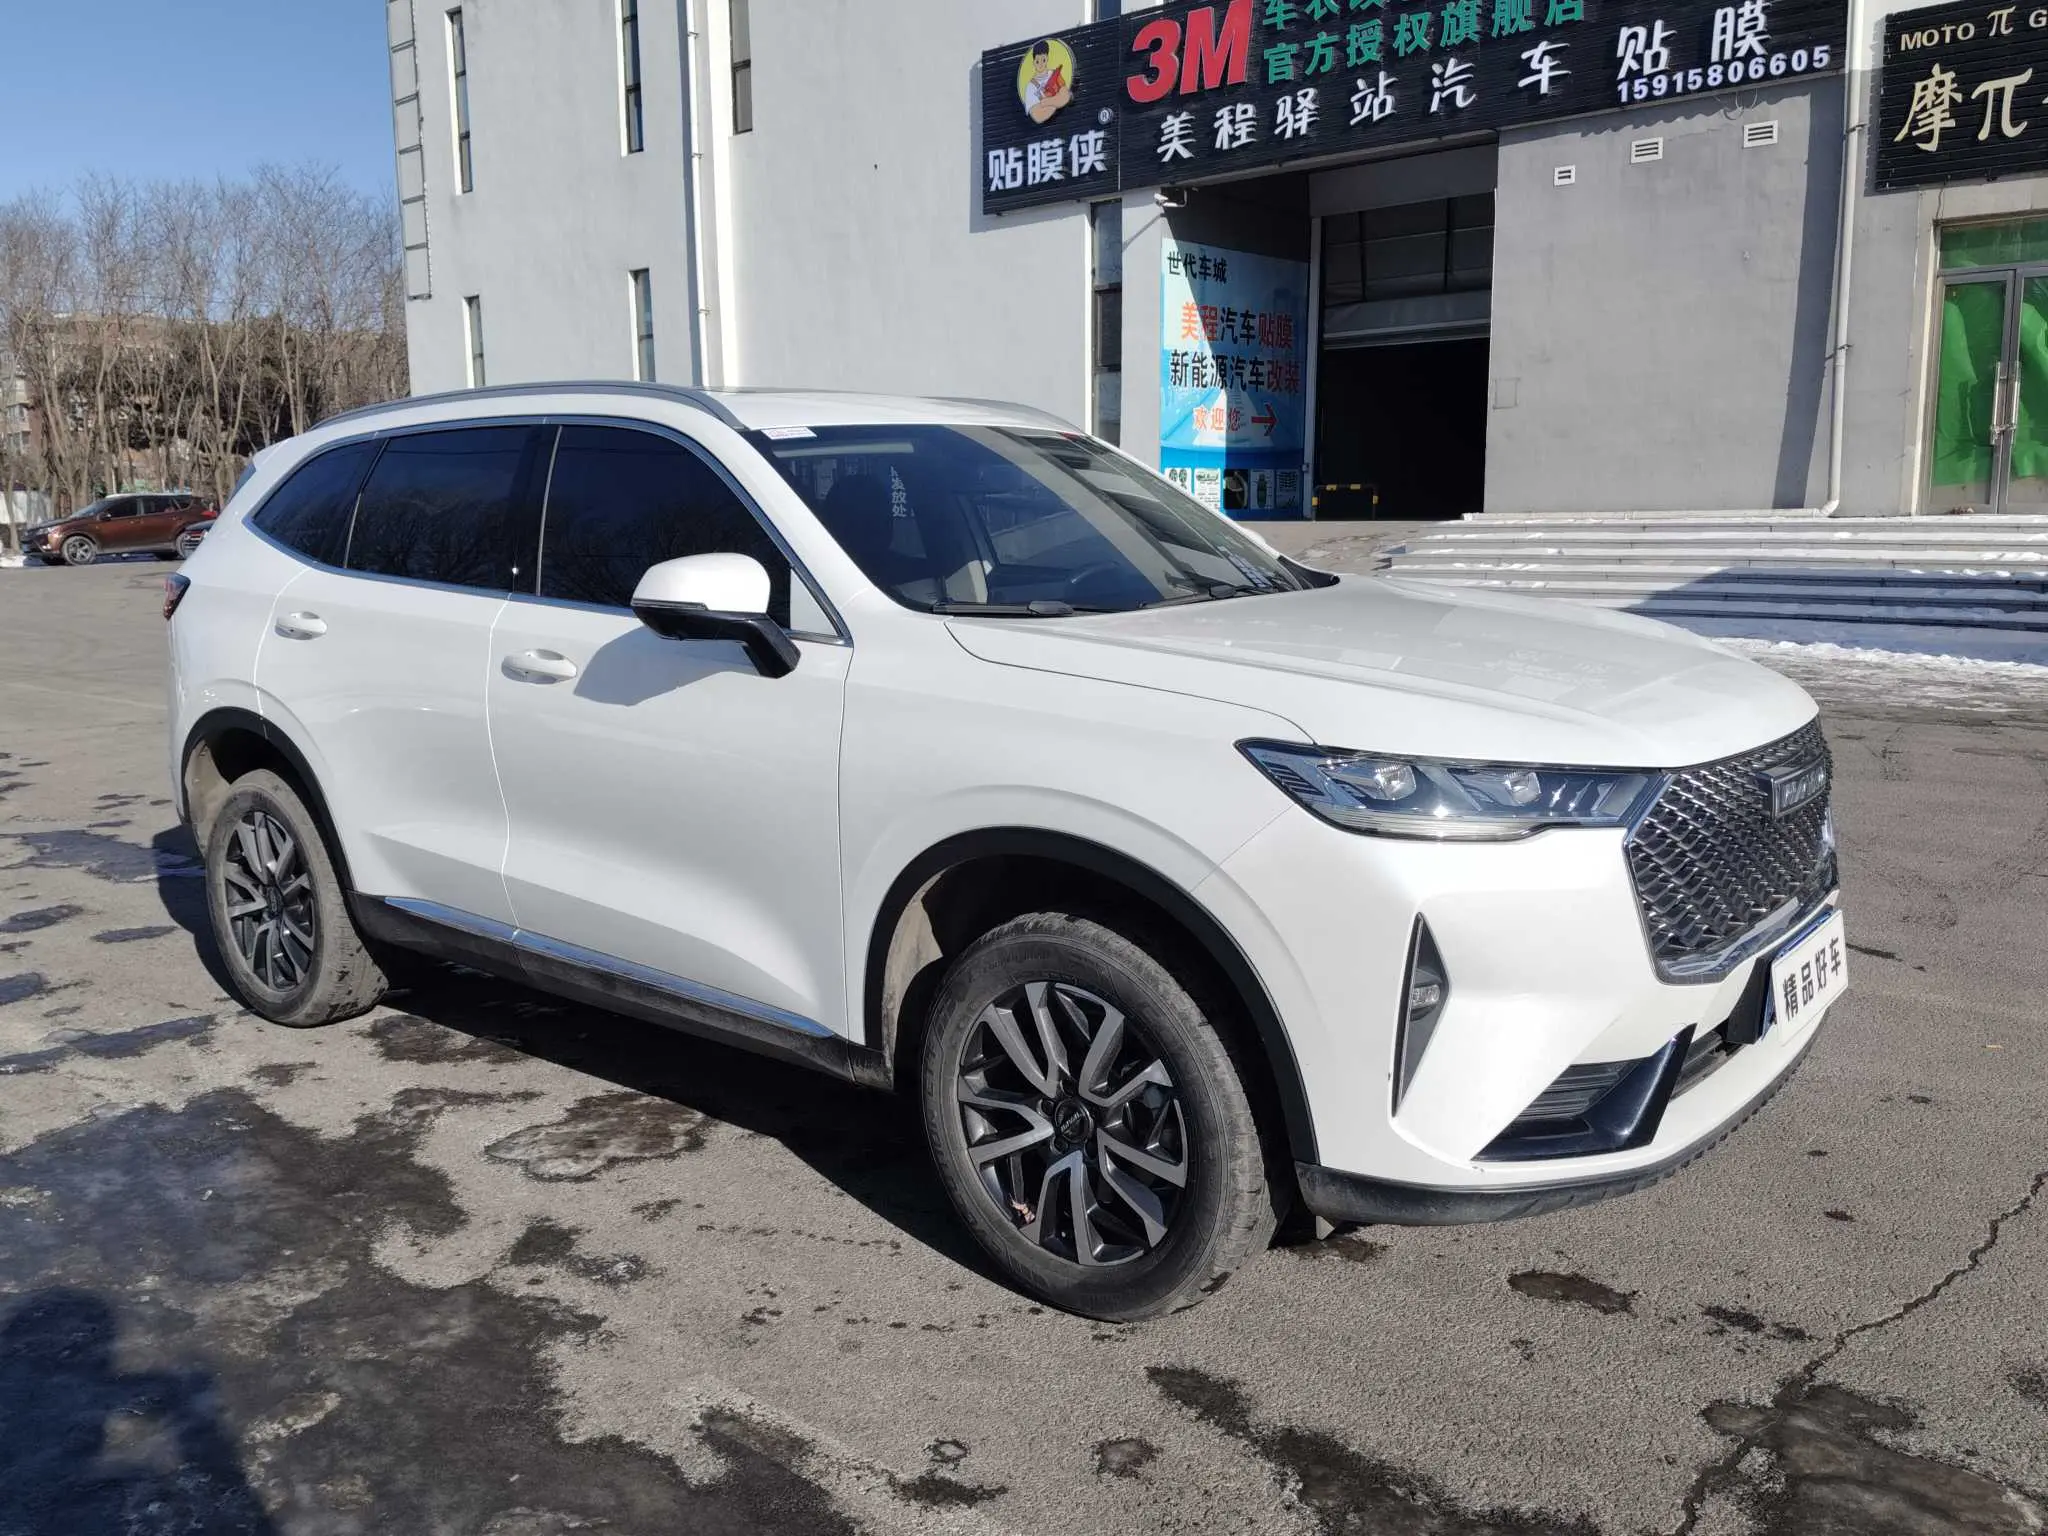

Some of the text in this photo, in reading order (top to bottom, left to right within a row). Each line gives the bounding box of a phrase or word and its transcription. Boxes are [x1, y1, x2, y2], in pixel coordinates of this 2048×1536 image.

[1126, 0, 1256, 104] 3M
[1263, 0, 1586, 84] 官方授权旗舰店
[1900, 22, 1975, 51] MOTO
[1616, 45, 1831, 102] 15915806605
[988, 129, 1107, 192] 贴膜侠
[1167, 250, 1228, 284] 世代车城
[1181, 301, 1293, 349] 美程汽车贴膜
[1170, 348, 1301, 395] 新能源汽车改装
[1193, 405, 1241, 432] 欢迎您
[1782, 936, 1842, 1022] 精品好车
